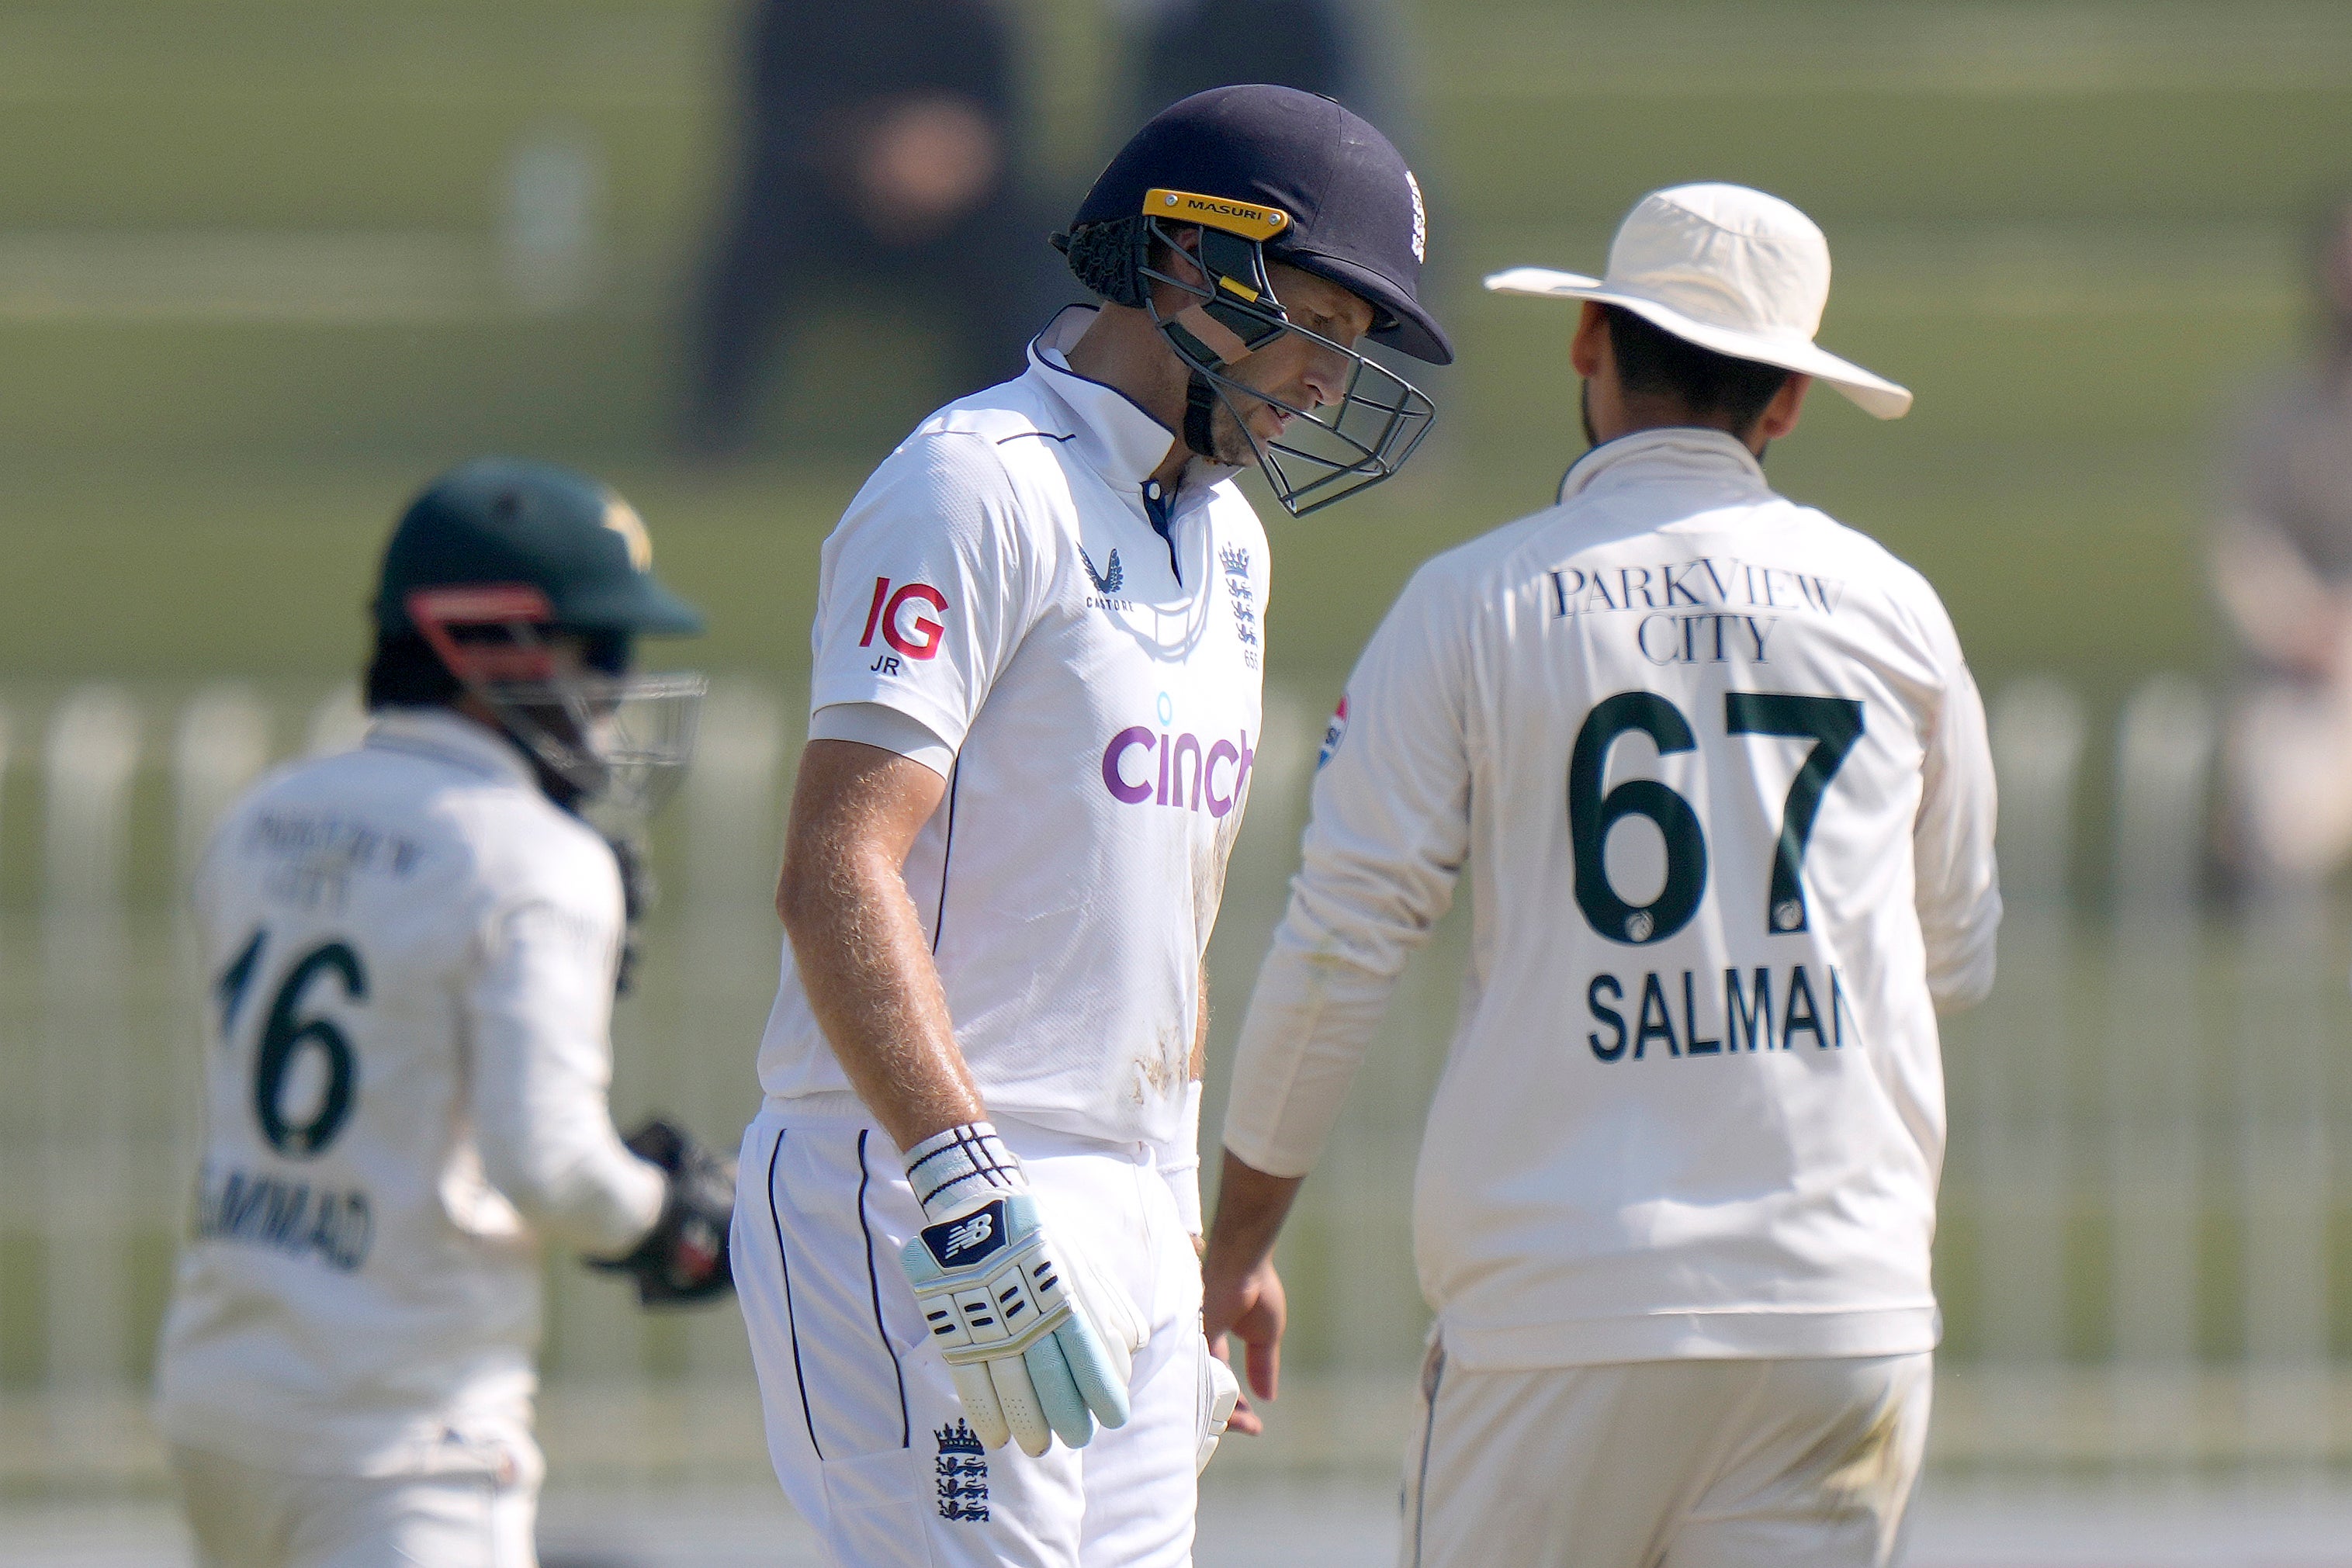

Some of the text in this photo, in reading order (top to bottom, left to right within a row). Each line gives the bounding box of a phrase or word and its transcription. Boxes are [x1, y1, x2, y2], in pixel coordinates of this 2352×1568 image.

[1187, 199, 1262, 220] MASURI
[858, 576, 949, 660] IG
[1086, 596, 1134, 612] CASTORE
[1638, 612, 1780, 666] CITY
[871, 655, 900, 676] JR
[1569, 691, 1866, 947] 67
